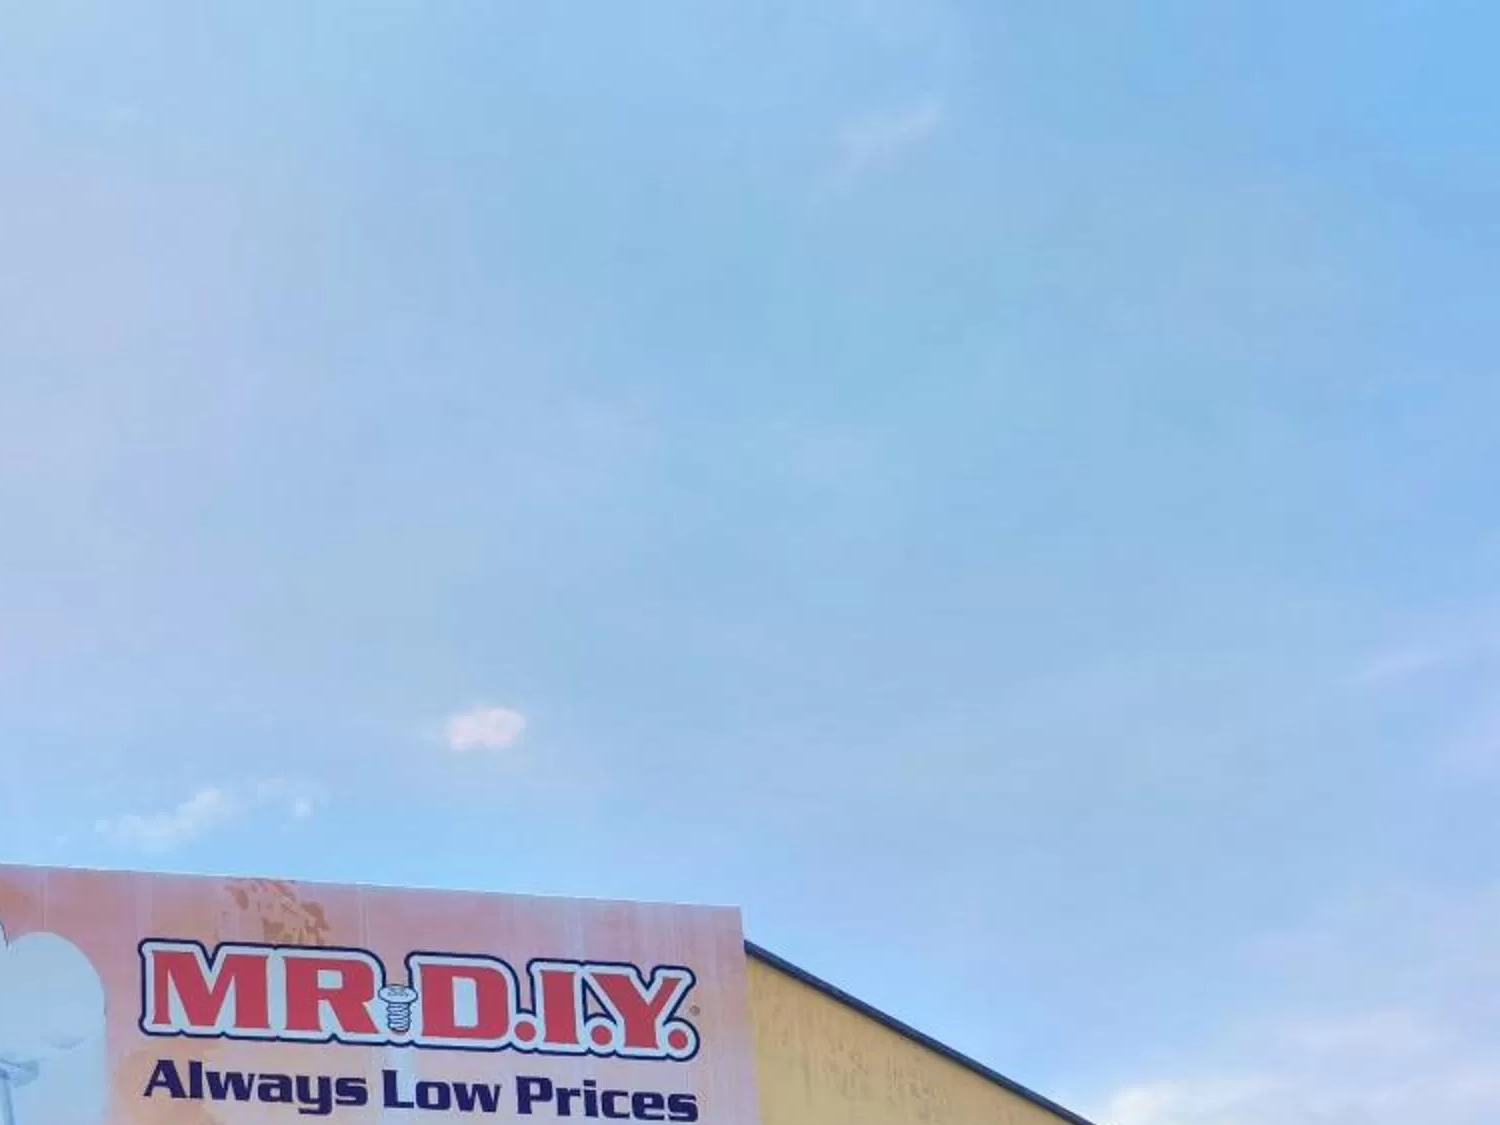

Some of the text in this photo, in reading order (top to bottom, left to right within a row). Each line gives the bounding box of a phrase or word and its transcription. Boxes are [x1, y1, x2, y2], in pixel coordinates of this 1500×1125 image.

[144, 1060, 698, 1122] Always Low Prices
